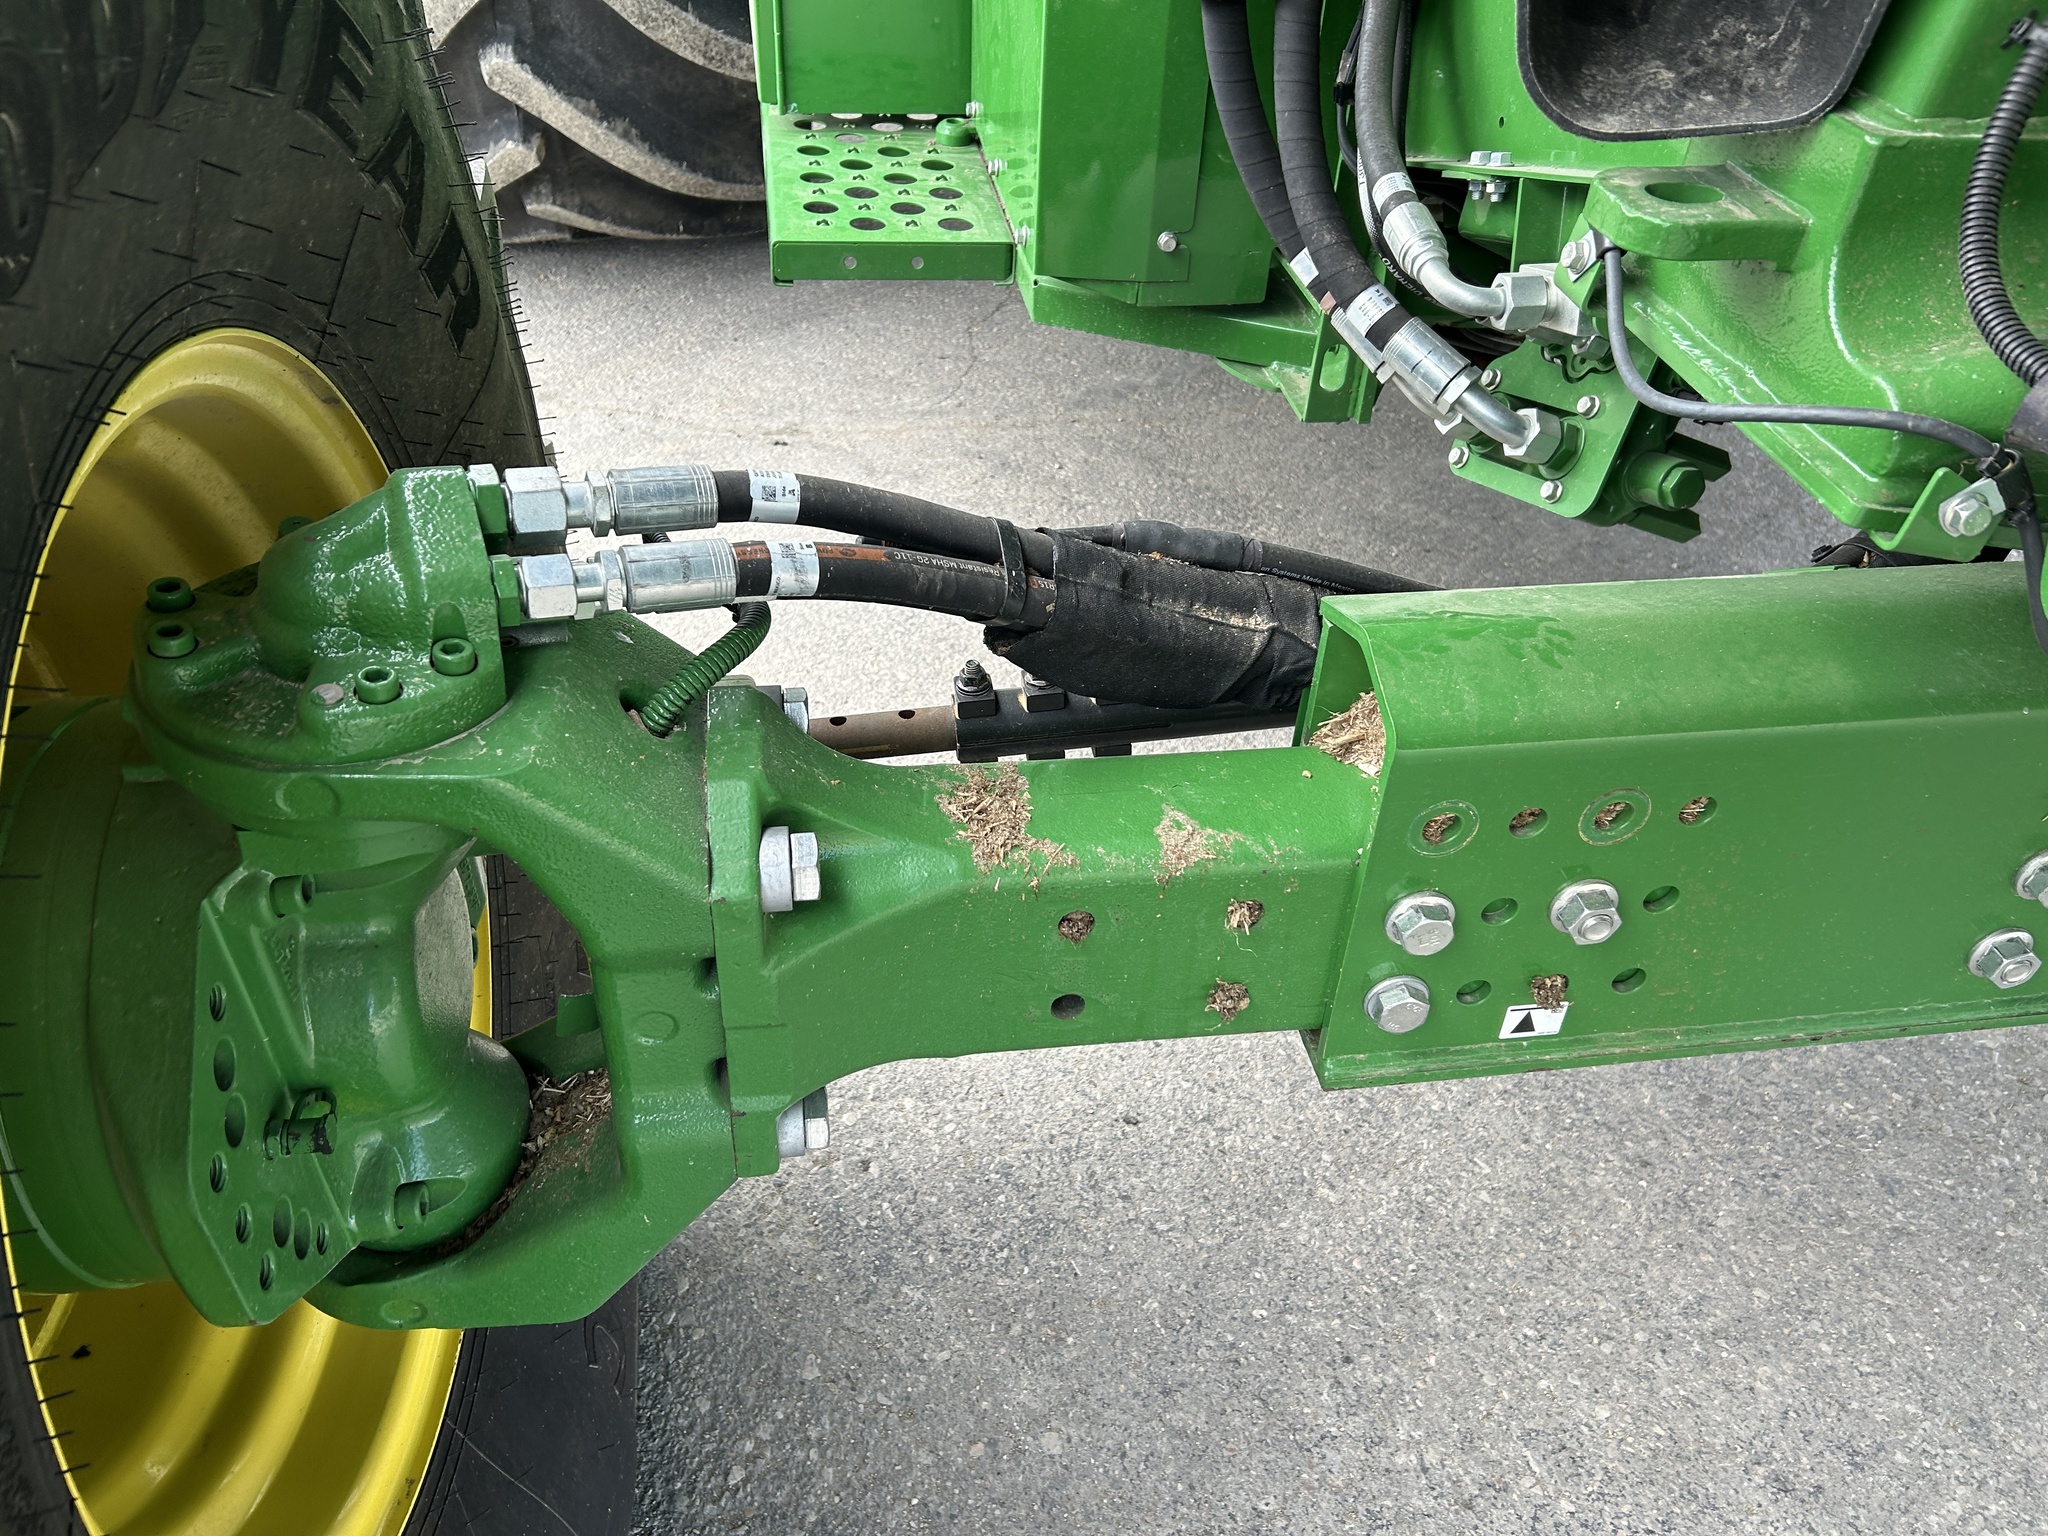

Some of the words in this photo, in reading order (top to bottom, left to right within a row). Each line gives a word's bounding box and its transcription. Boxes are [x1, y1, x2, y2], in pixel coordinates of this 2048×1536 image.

[894, 551, 929, 564] 2G-11C
[931, 557, 958, 570] MSHA
[959, 562, 1000, 577] Resistant
[1271, 567, 1301, 579] Systems
[1302, 574, 1322, 584] Made
